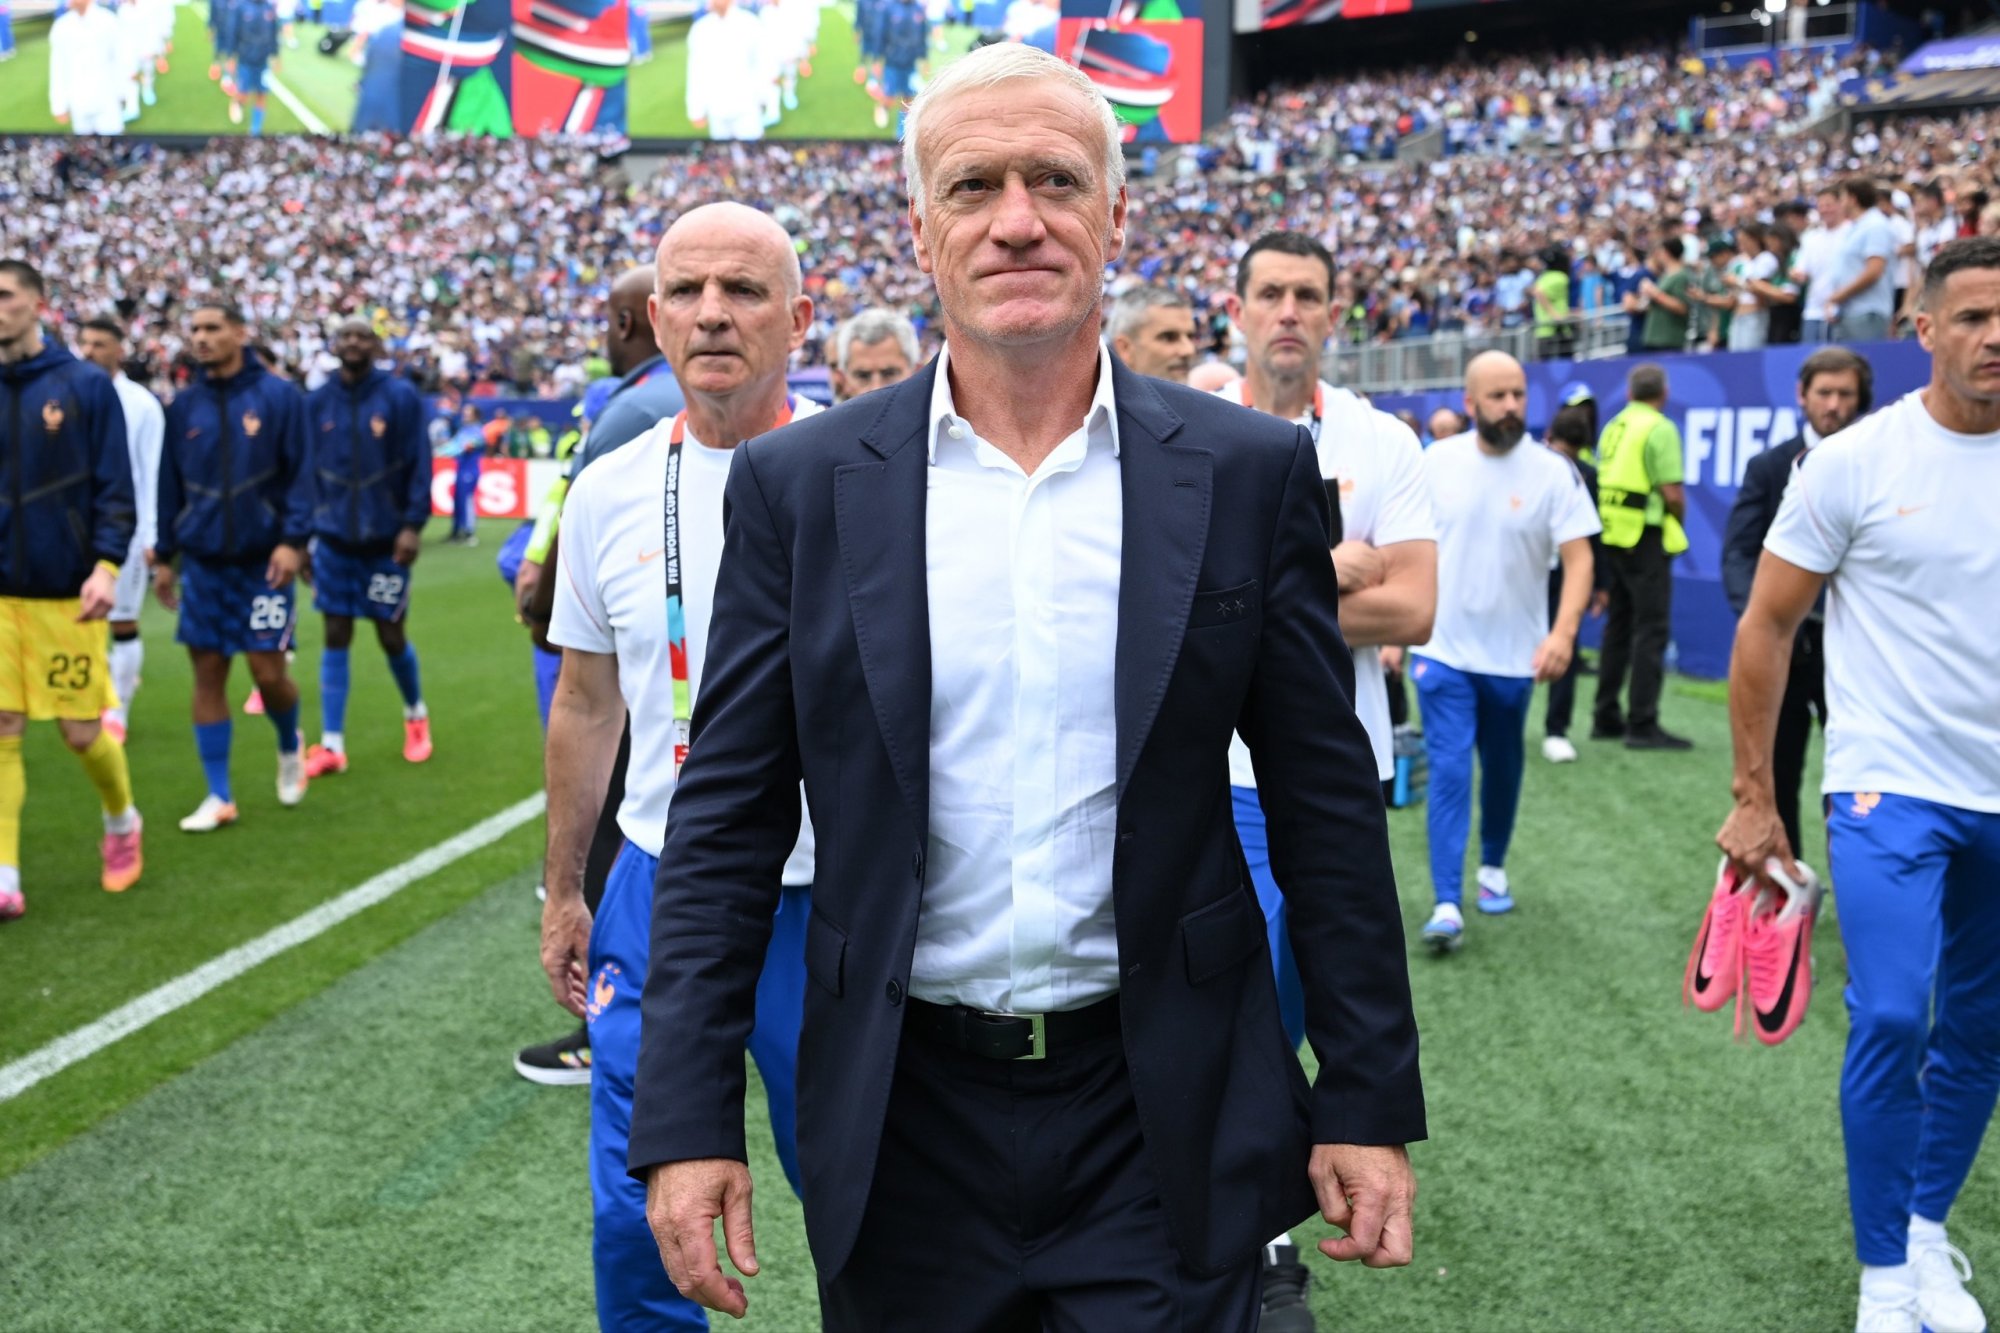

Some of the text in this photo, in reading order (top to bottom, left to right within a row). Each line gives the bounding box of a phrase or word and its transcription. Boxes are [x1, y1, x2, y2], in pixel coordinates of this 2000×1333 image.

[666, 452, 679, 585] FIFA WORLD CUP 2026
[367, 573, 404, 605] 22
[249, 594, 287, 630] 26
[47, 653, 91, 690] 23
